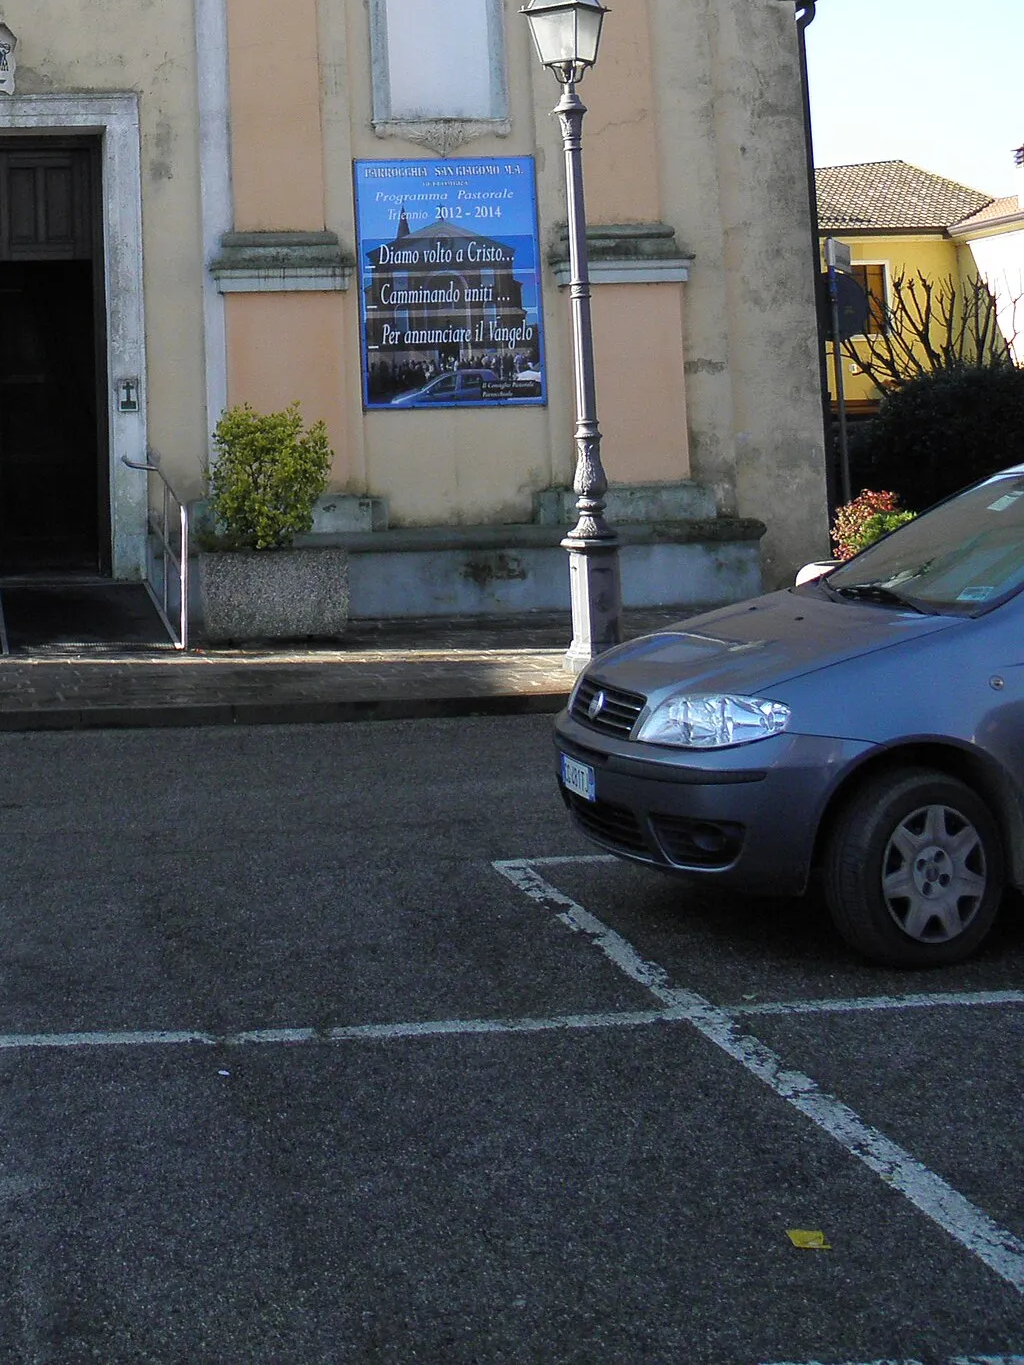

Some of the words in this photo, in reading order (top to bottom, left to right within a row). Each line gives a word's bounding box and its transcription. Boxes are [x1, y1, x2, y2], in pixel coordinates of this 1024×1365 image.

[364, 167, 428, 178] PARROCCHIA
[434, 166, 454, 176] SAN
[455, 165, 500, 176] GIACOMO
[375, 191, 448, 204] Programma
[457, 188, 514, 200] Pastorale
[387, 208, 428, 220] Triennio
[435, 206, 462, 219] 2012
[474, 205, 502, 218] 2014
[379, 243, 419, 265] Diamo
[423, 243, 452, 264] volto
[455, 250, 463, 263] a
[467, 241, 515, 262] Cristo...
[380, 281, 460, 305] Camminando
[464, 284, 494, 302] uniti
[382, 323, 400, 345] Per
[404, 325, 471, 345] annunciare
[475, 320, 484, 342] il
[489, 319, 533, 350] Vangelo
